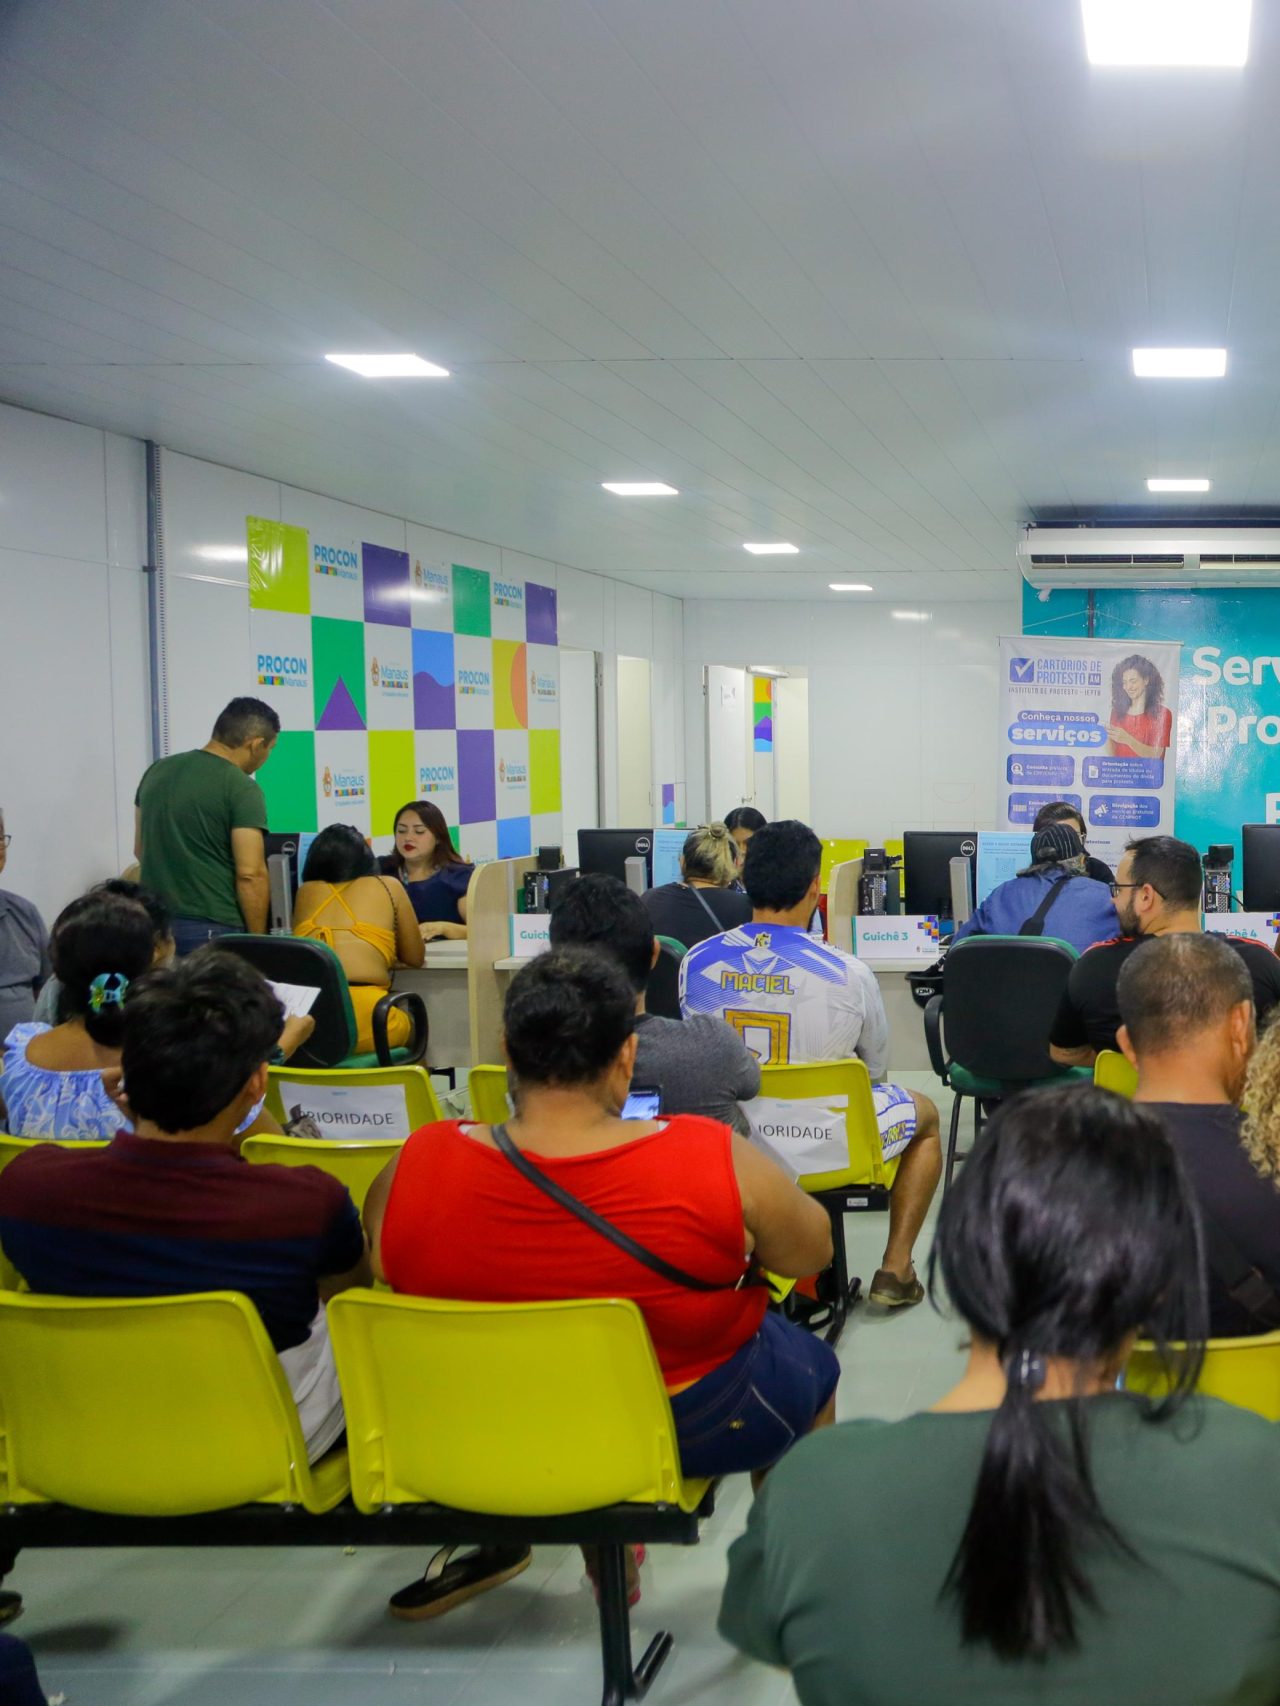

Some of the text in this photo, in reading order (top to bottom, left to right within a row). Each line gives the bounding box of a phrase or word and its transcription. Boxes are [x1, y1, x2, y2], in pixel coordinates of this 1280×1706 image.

[313, 544, 358, 569] PROCON
[493, 581, 522, 600] PROCON
[257, 654, 308, 675] PROCON
[1090, 660, 1102, 672] DE
[380, 665, 409, 681] Manaus
[458, 669, 490, 685] PROCON
[1036, 671, 1086, 685] PROTESTO
[1021, 712, 1096, 723] Conheça nossos
[1012, 725, 1102, 746] serviços
[334, 773, 365, 787] Manaus
[420, 766, 454, 782] PROCON
[862, 931, 909, 942] Guichê 3
[1250, 929, 1258, 938] 4
[721, 970, 795, 995] MACIEL
